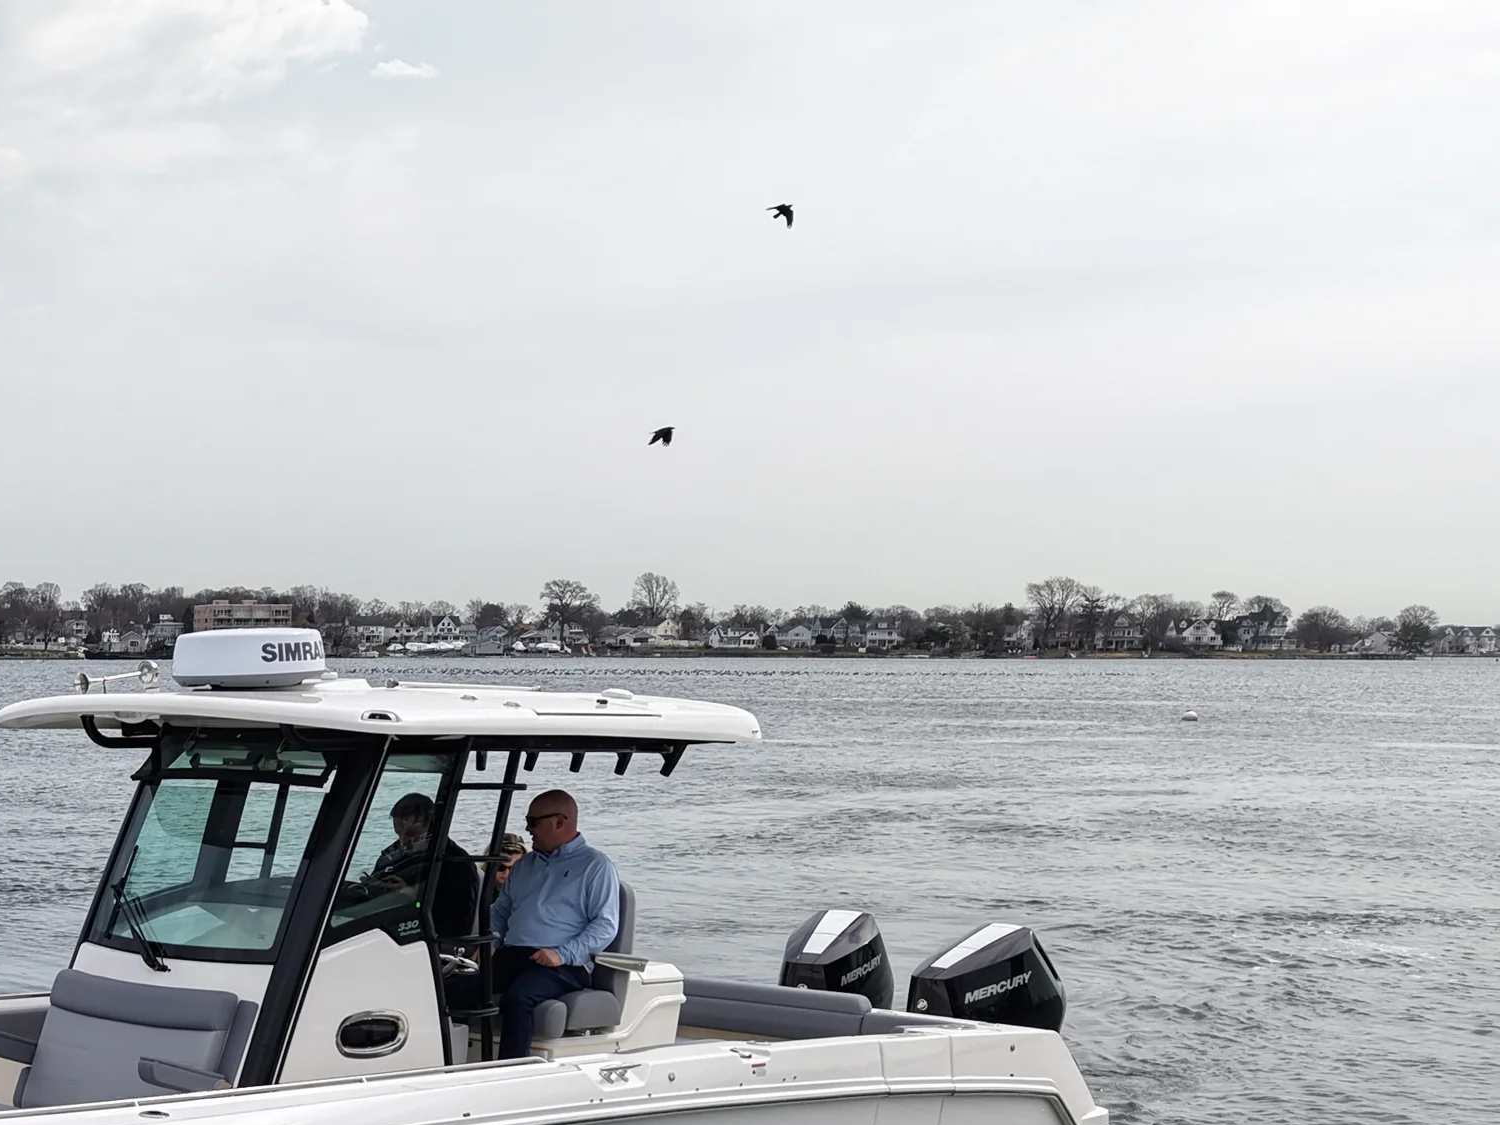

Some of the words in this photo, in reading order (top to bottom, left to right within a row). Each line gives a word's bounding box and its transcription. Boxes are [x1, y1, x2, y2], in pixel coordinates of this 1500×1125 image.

[261, 640, 324, 662] SIMRA
[840, 952, 882, 987] MERCURY
[964, 970, 1032, 1005] MERCURY
